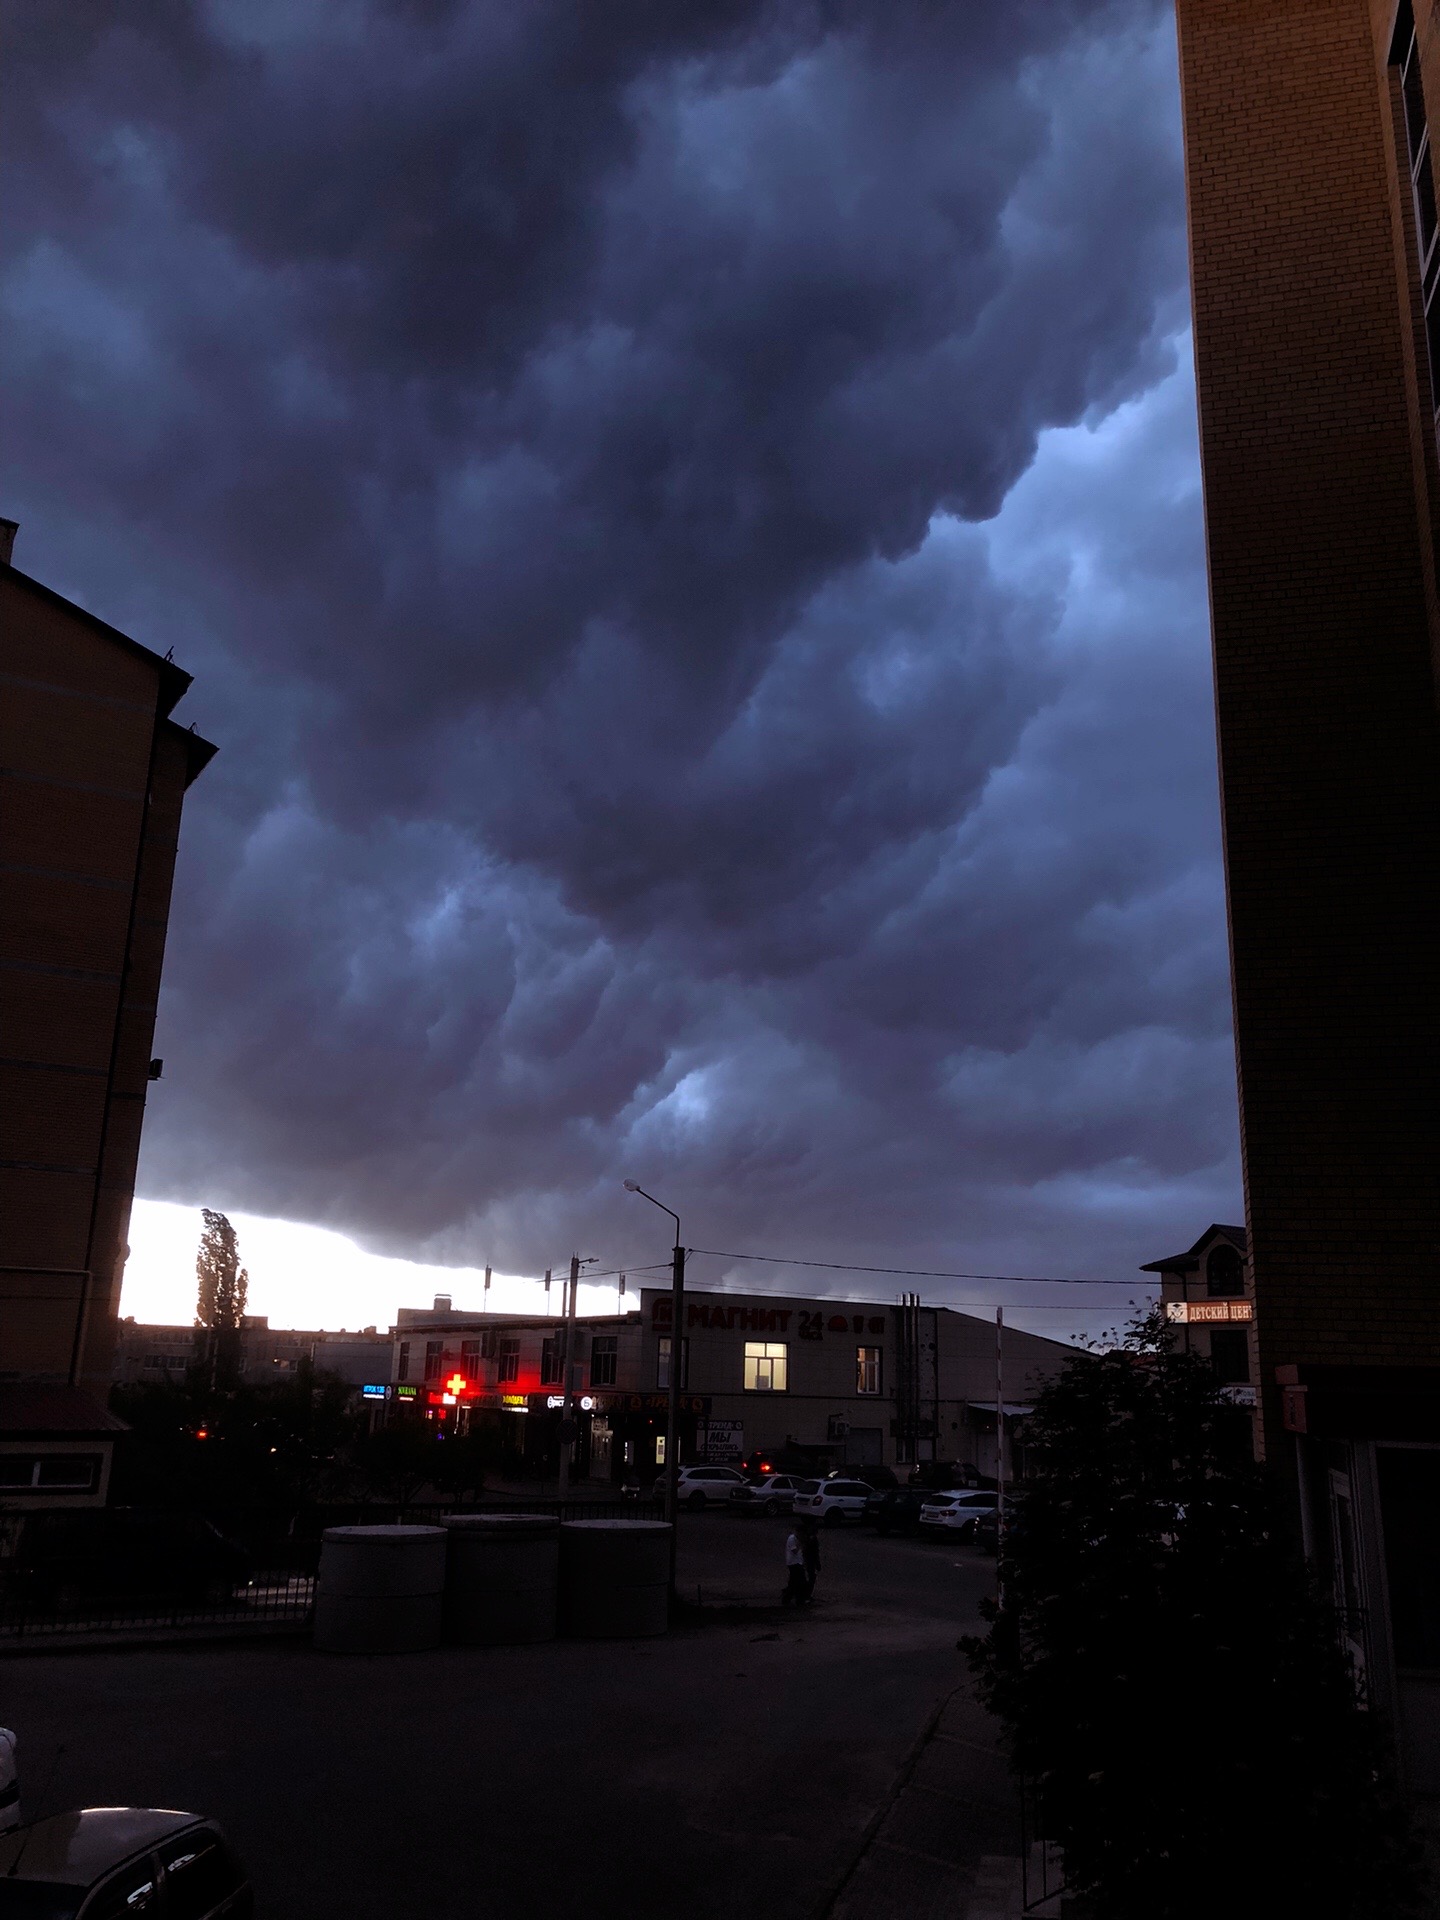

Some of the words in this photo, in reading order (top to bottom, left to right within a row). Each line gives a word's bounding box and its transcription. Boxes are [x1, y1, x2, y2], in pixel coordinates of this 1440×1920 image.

[687, 1304, 793, 1332] МАГНИТ
[798, 1310, 824, 1332] 24
[1189, 1302, 1229, 1322] ДЕТСКИЙ
[708, 1431, 732, 1443] МЫ
